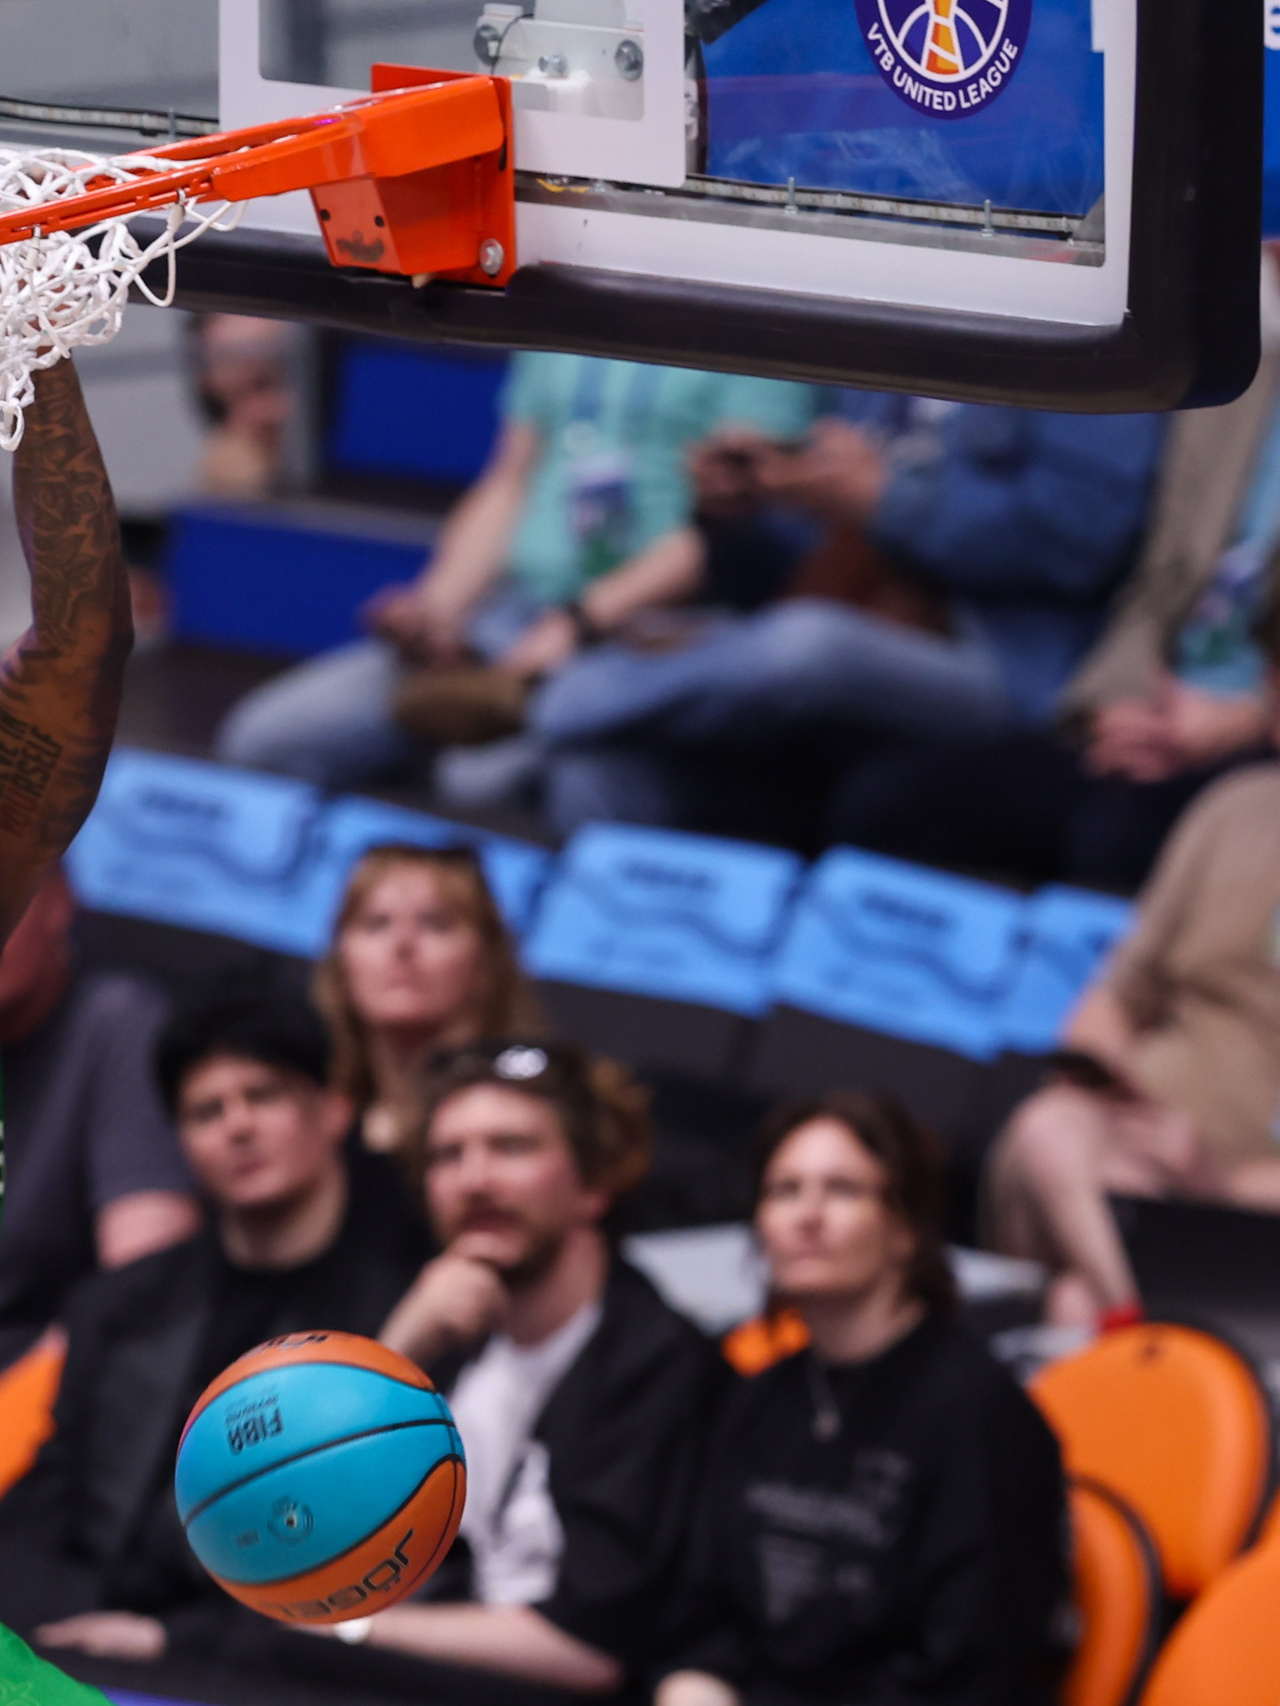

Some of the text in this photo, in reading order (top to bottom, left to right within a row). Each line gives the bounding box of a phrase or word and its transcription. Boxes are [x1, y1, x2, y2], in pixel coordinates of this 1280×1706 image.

[867, 22, 1018, 111] VTB UNITED LEAGUE
[227, 1408, 284, 1456] FIBA
